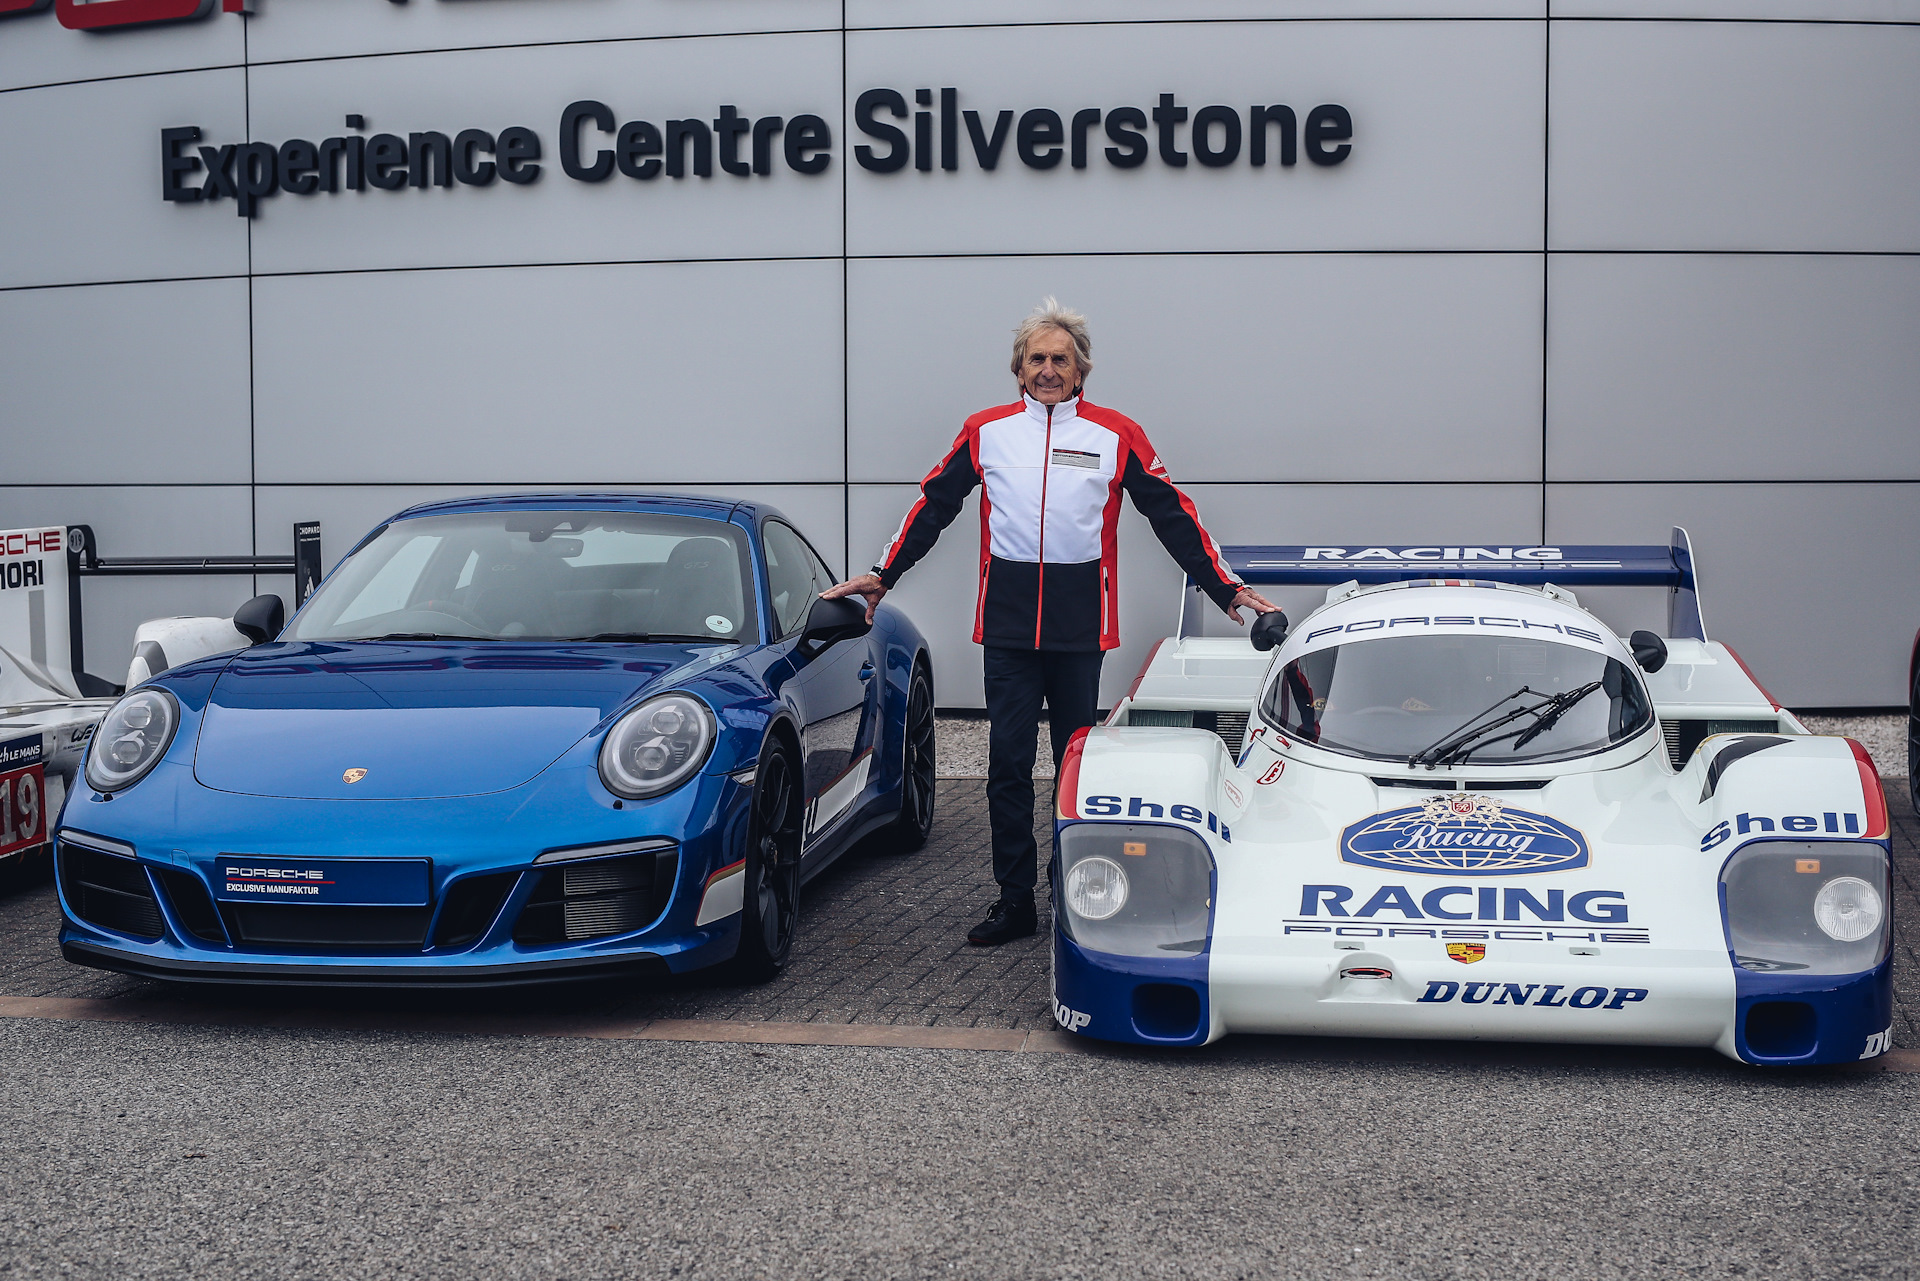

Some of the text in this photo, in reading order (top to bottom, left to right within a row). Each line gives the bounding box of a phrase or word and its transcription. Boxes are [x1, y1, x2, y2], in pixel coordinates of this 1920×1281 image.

[161, 87, 1355, 218] Experience Centre Silverstone
[1302, 547, 1563, 560] RACING
[0, 559, 44, 590] ORI
[1304, 615, 1604, 645] PORSCHE
[10, 750, 20, 761] LE
[20, 744, 41, 759] MANS
[1084, 796, 1232, 844] Shell
[1700, 812, 1860, 853] Shell
[1393, 823, 1536, 854] Racing
[225, 866, 324, 880] PORSCHE
[226, 882, 319, 895] EXCLUSIVE MANUFAKTUR
[1299, 884, 1629, 924] RACING
[1284, 924, 1651, 945] PORSCHE
[1416, 980, 1650, 1011] DUNLOP
